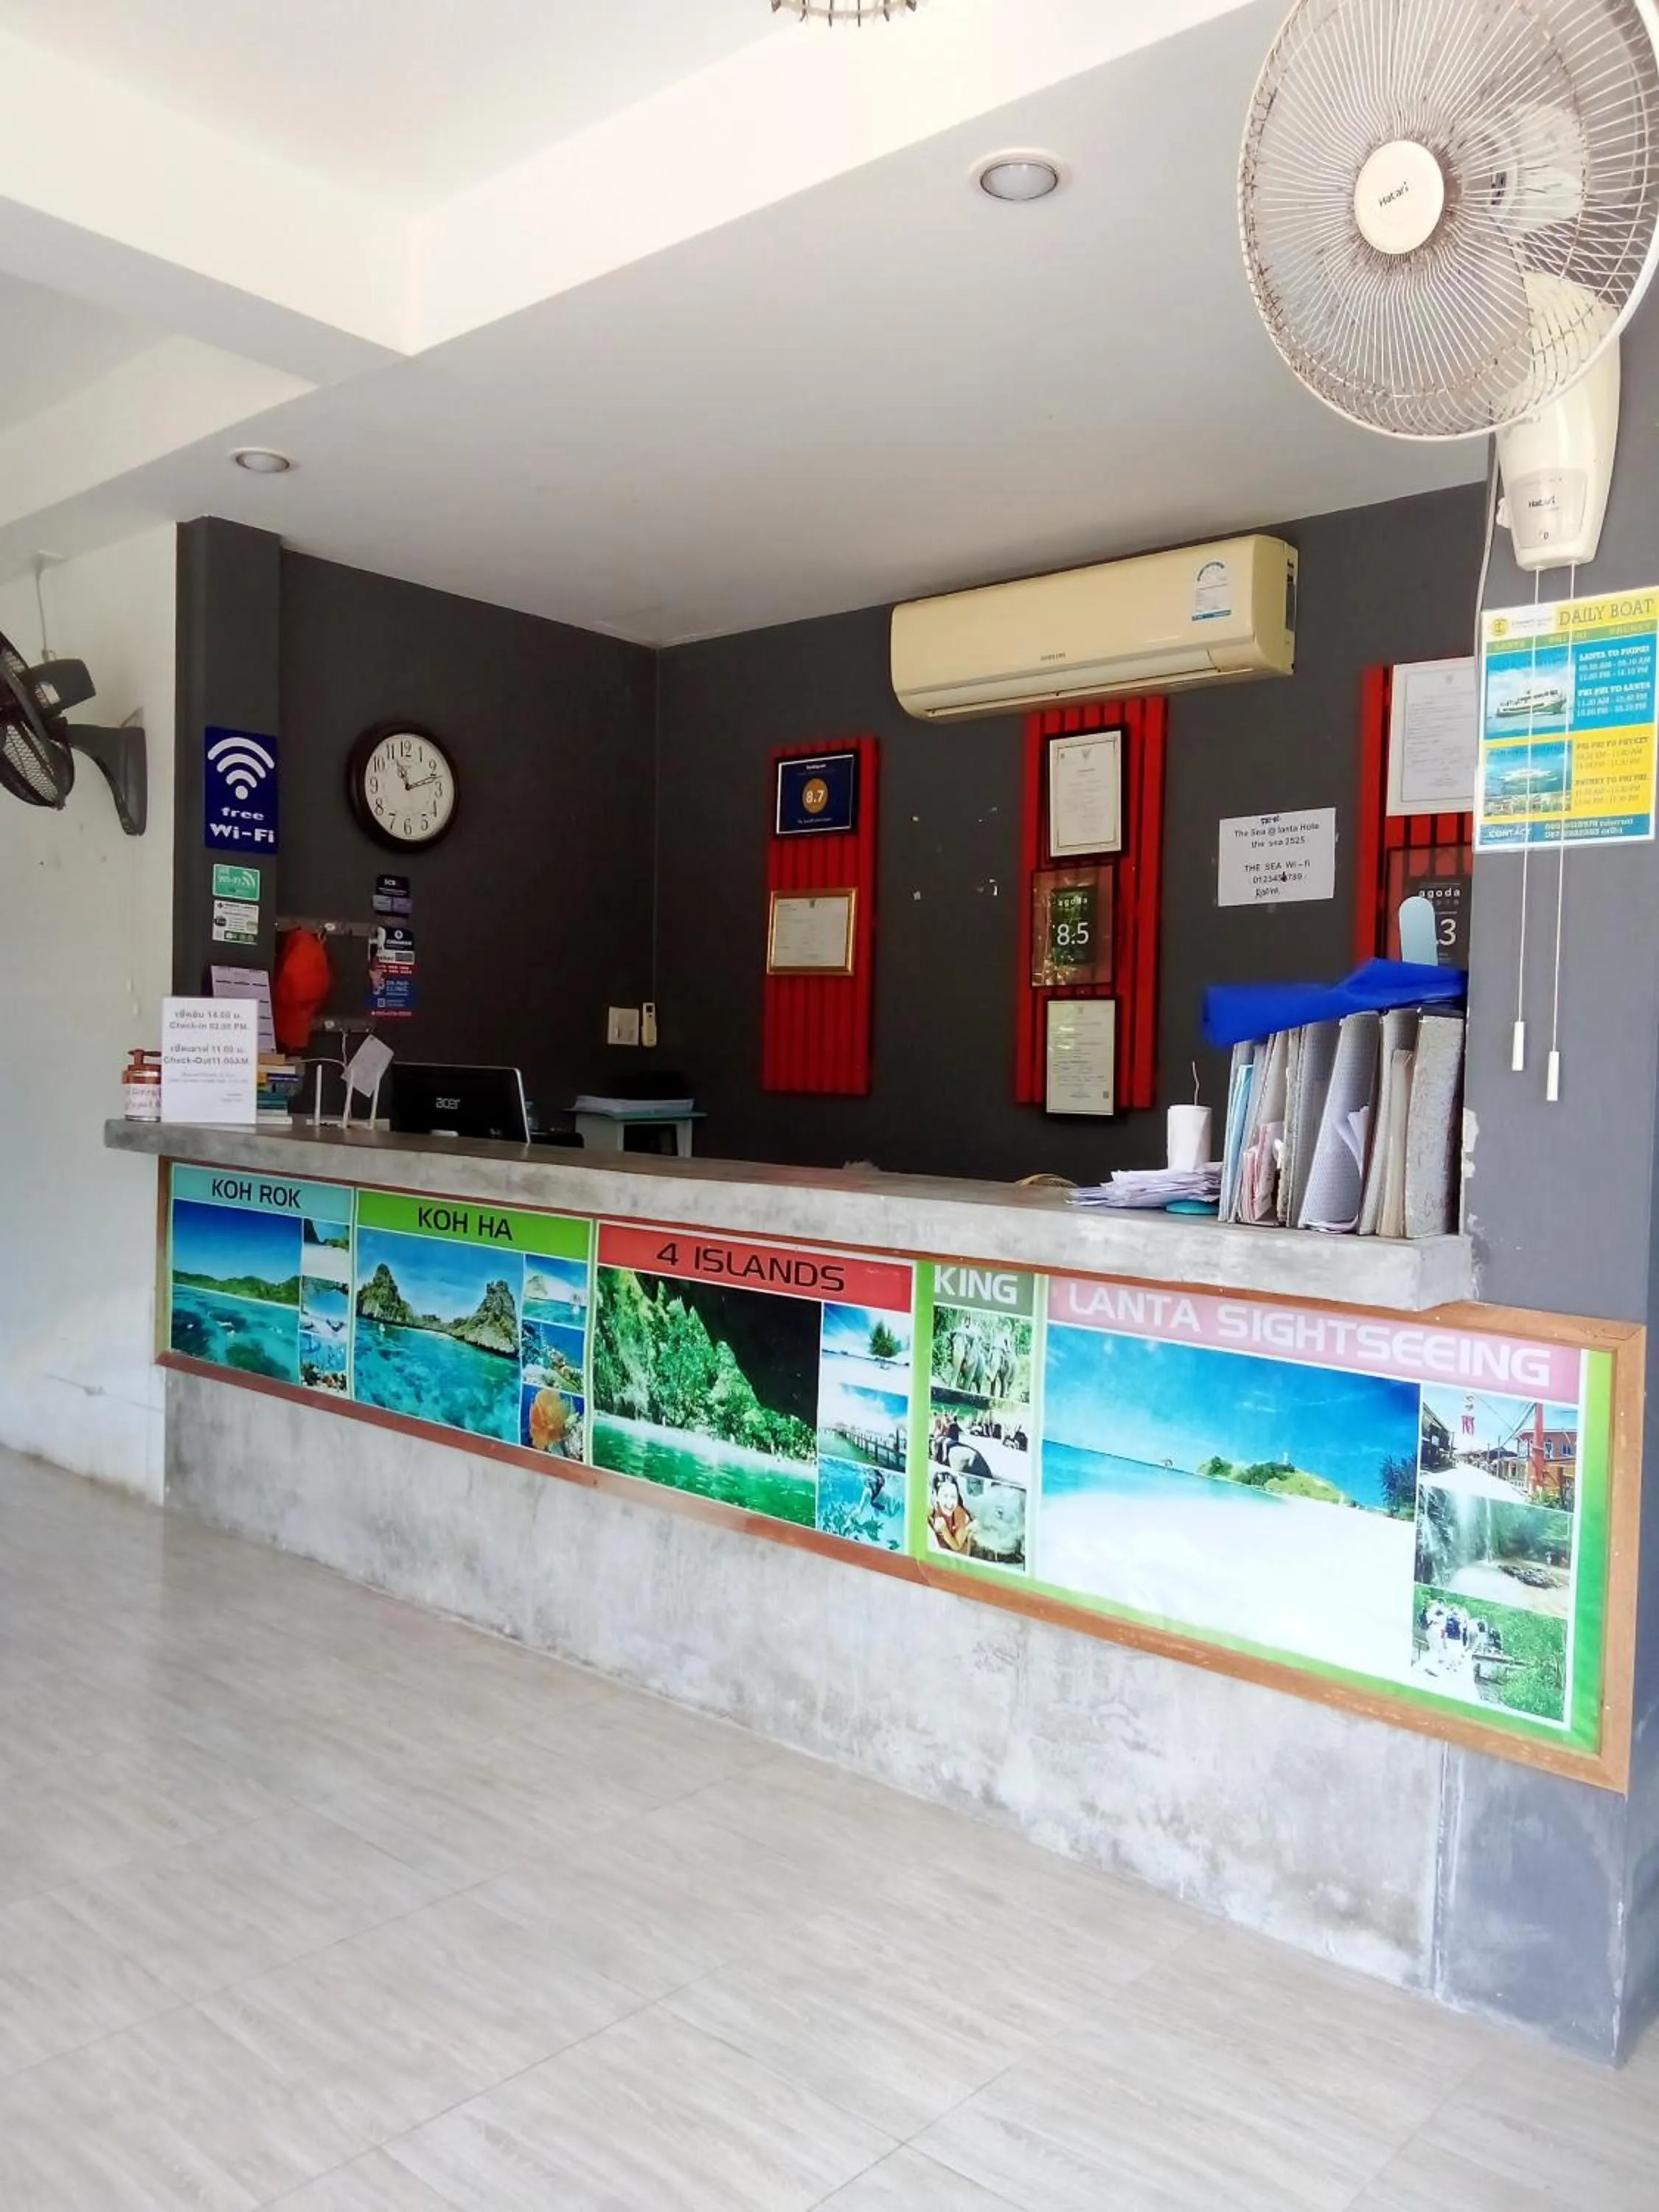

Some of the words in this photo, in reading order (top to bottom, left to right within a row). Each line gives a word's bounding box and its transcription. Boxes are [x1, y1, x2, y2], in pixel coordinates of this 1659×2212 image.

[1559, 605, 1606, 626] DAILY
[1610, 598, 1654, 618] BOAT
[386, 743, 394, 760] 11
[400, 740, 411, 757] 12
[419, 745, 422, 762] 1
[373, 755, 385, 773] 10
[428, 759, 437, 776] 2
[369, 776, 378, 793] 9
[434, 780, 443, 798] 3
[805, 790, 824, 803] 8.7
[221, 806, 265, 821] free
[375, 797, 384, 815] 8
[389, 812, 396, 830] 7
[403, 818, 412, 835] 6
[421, 813, 428, 830] 5
[209, 823, 275, 843] Wi-Fi
[1265, 862, 1281, 871] SEA
[1419, 887, 1461, 899] agoda
[1057, 922, 1089, 945] 8.5
[436, 1097, 461, 1110] acer
[212, 1178, 252, 1202] KOH
[259, 1183, 302, 1209] ROK
[418, 1206, 467, 1234] KOH
[478, 1214, 513, 1242] HA
[656, 1242, 679, 1267] 4
[695, 1245, 846, 1293] ISLANDS
[934, 1264, 1018, 1305] KING
[1068, 1281, 1202, 1333] LANTA
[1217, 1303, 1552, 1387] SIGHTSEEING
